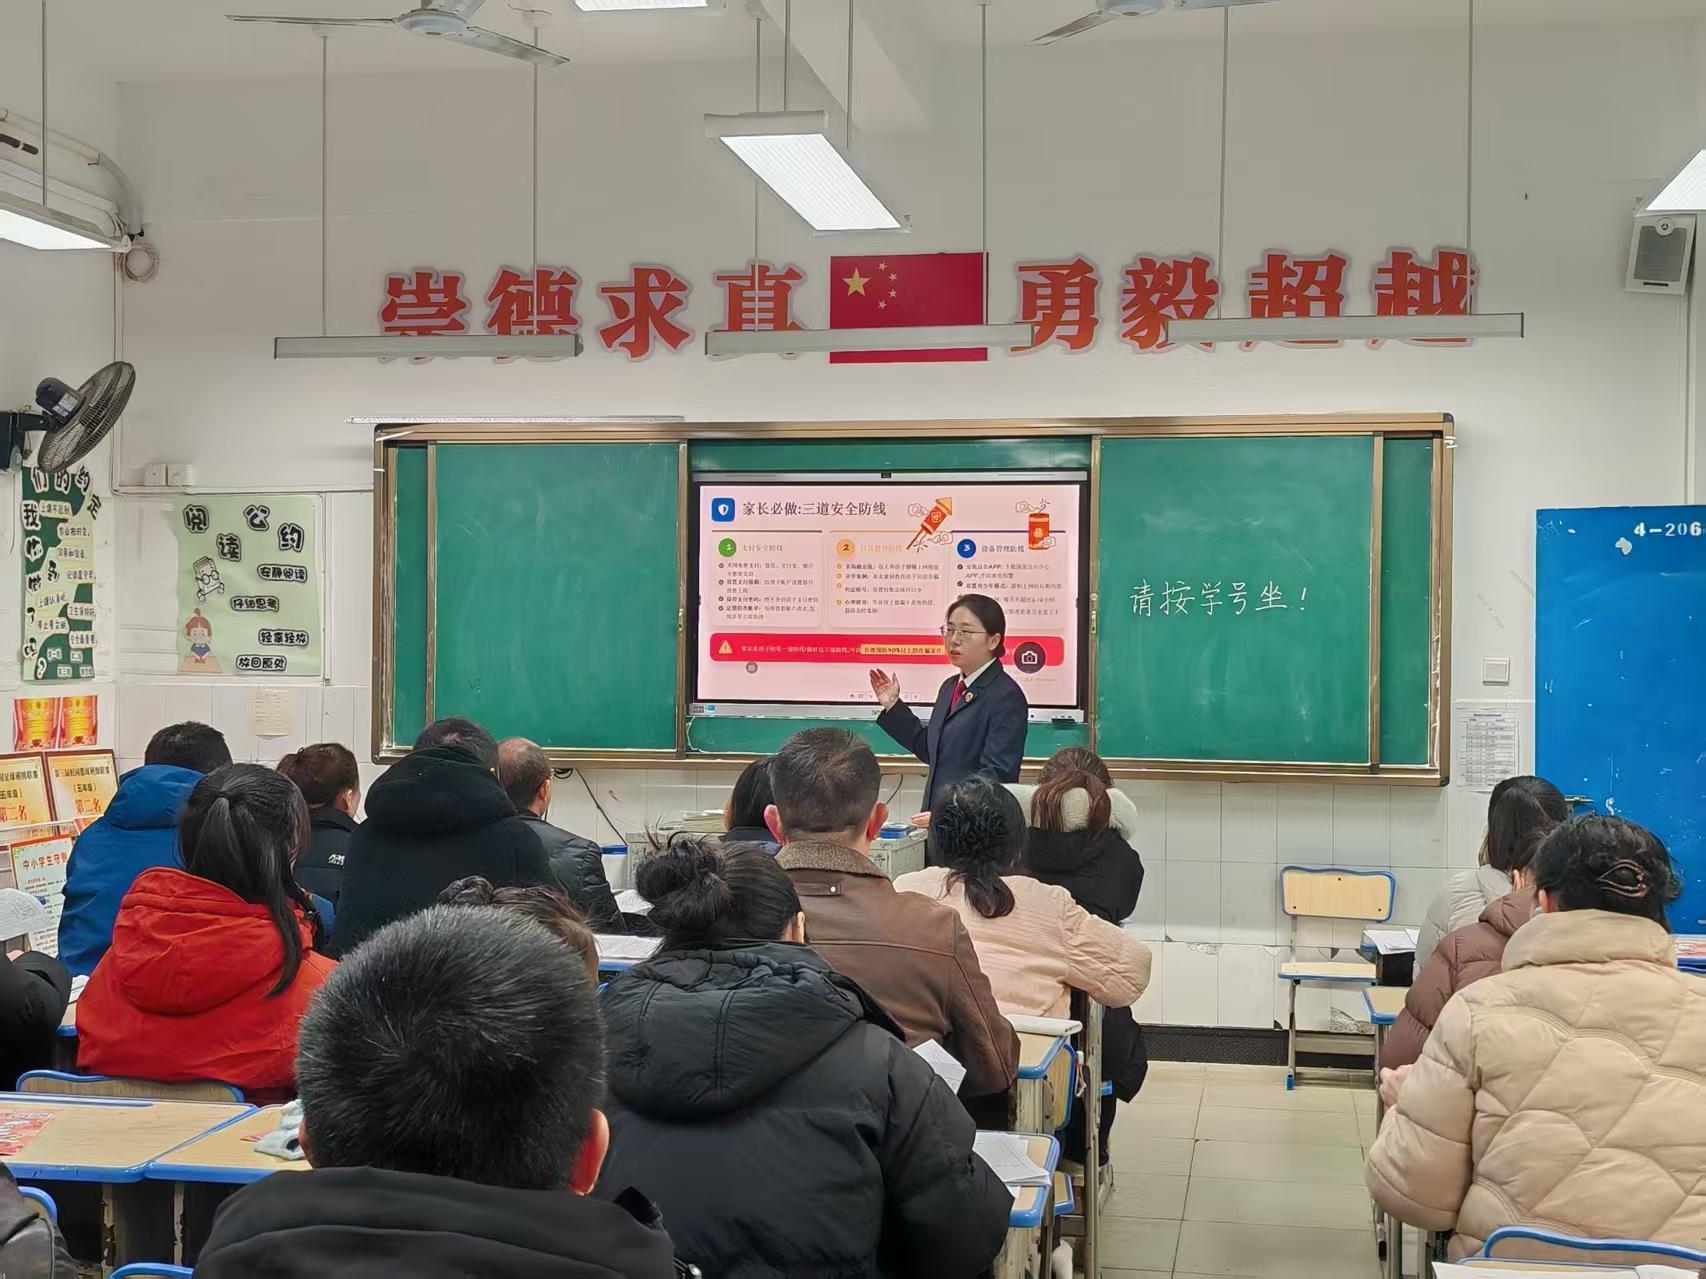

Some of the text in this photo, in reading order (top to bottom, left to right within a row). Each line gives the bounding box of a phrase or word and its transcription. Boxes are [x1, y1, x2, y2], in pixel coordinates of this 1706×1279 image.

[379, 250, 1477, 359] 崇德求真 勇毅超越
[1634, 521, 1702, 537] 4-206
[981, 545, 1025, 553] 设备管理防线
[259, 566, 307, 582] 安静阅读
[233, 597, 278, 612] 仔细思考
[261, 630, 308, 646] 轻拿轻放
[238, 656, 286, 671] 放回原处
[75, 797, 102, 815] 第二名
